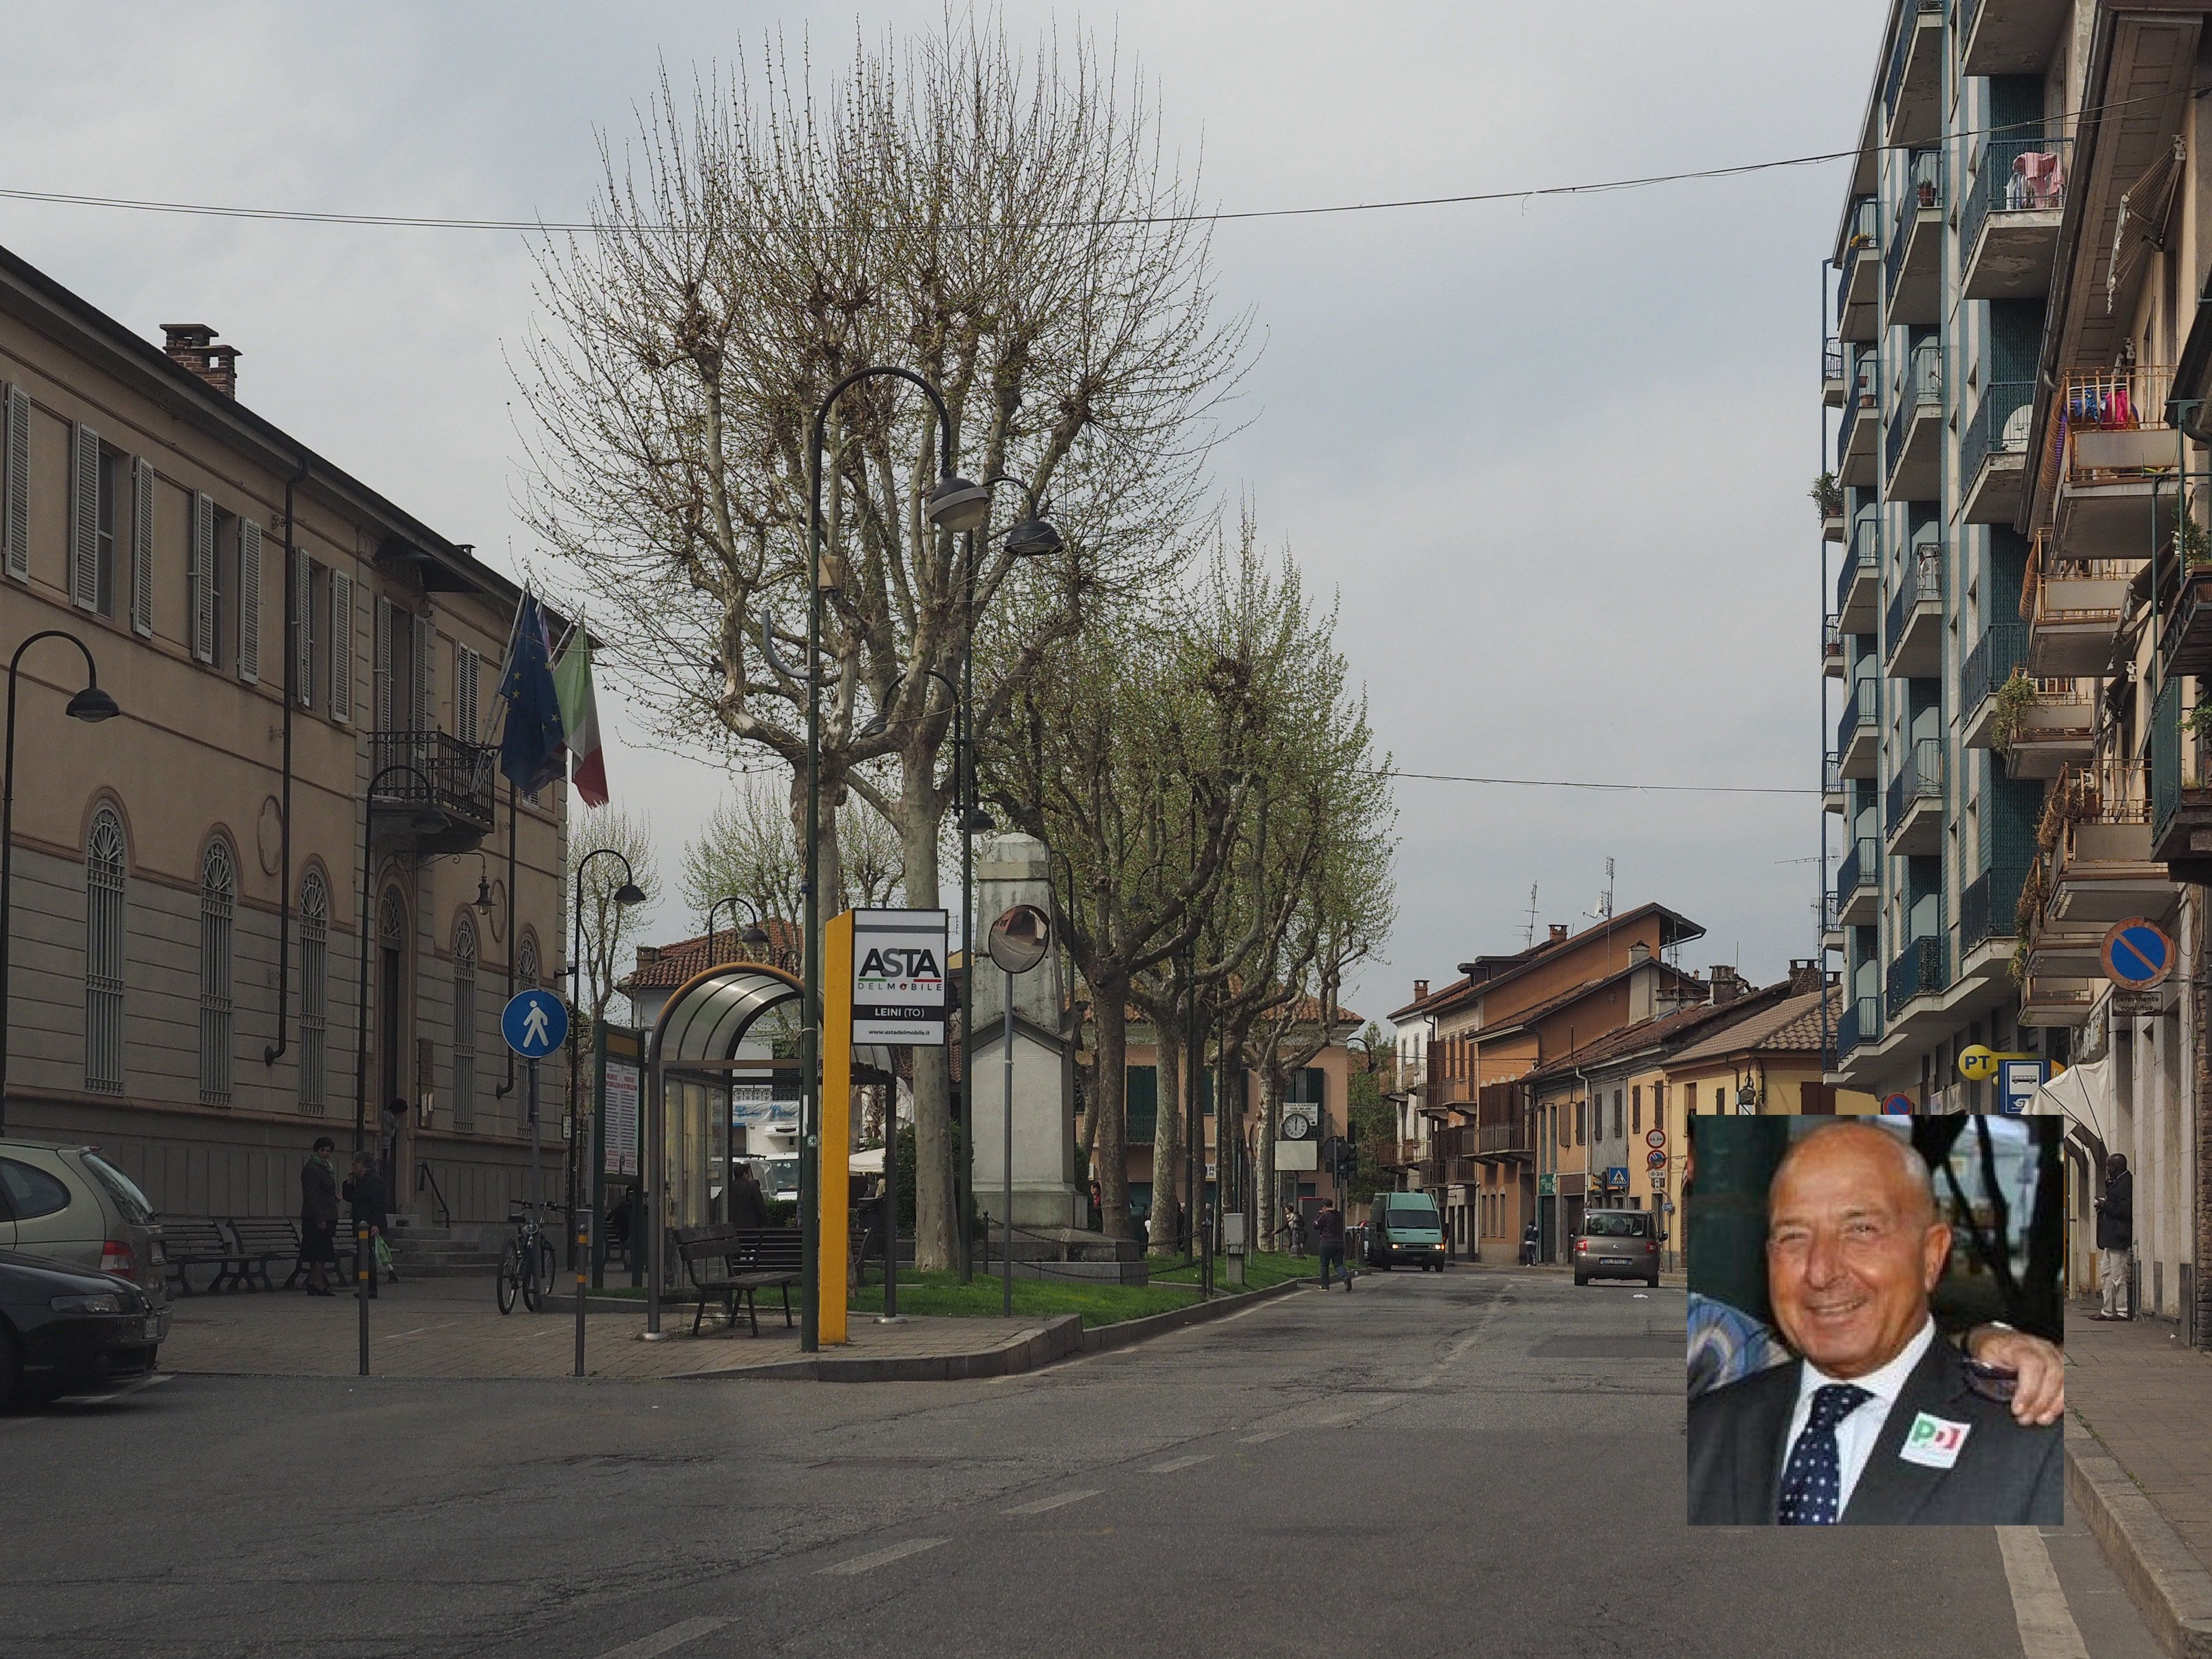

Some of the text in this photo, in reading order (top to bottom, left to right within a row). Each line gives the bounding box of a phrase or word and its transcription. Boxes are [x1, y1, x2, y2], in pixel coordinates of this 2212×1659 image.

[858, 948, 941, 978] ASTA
[874, 1008, 924, 1018] LEINI (TO)
[1965, 1055, 1990, 1070] PT
